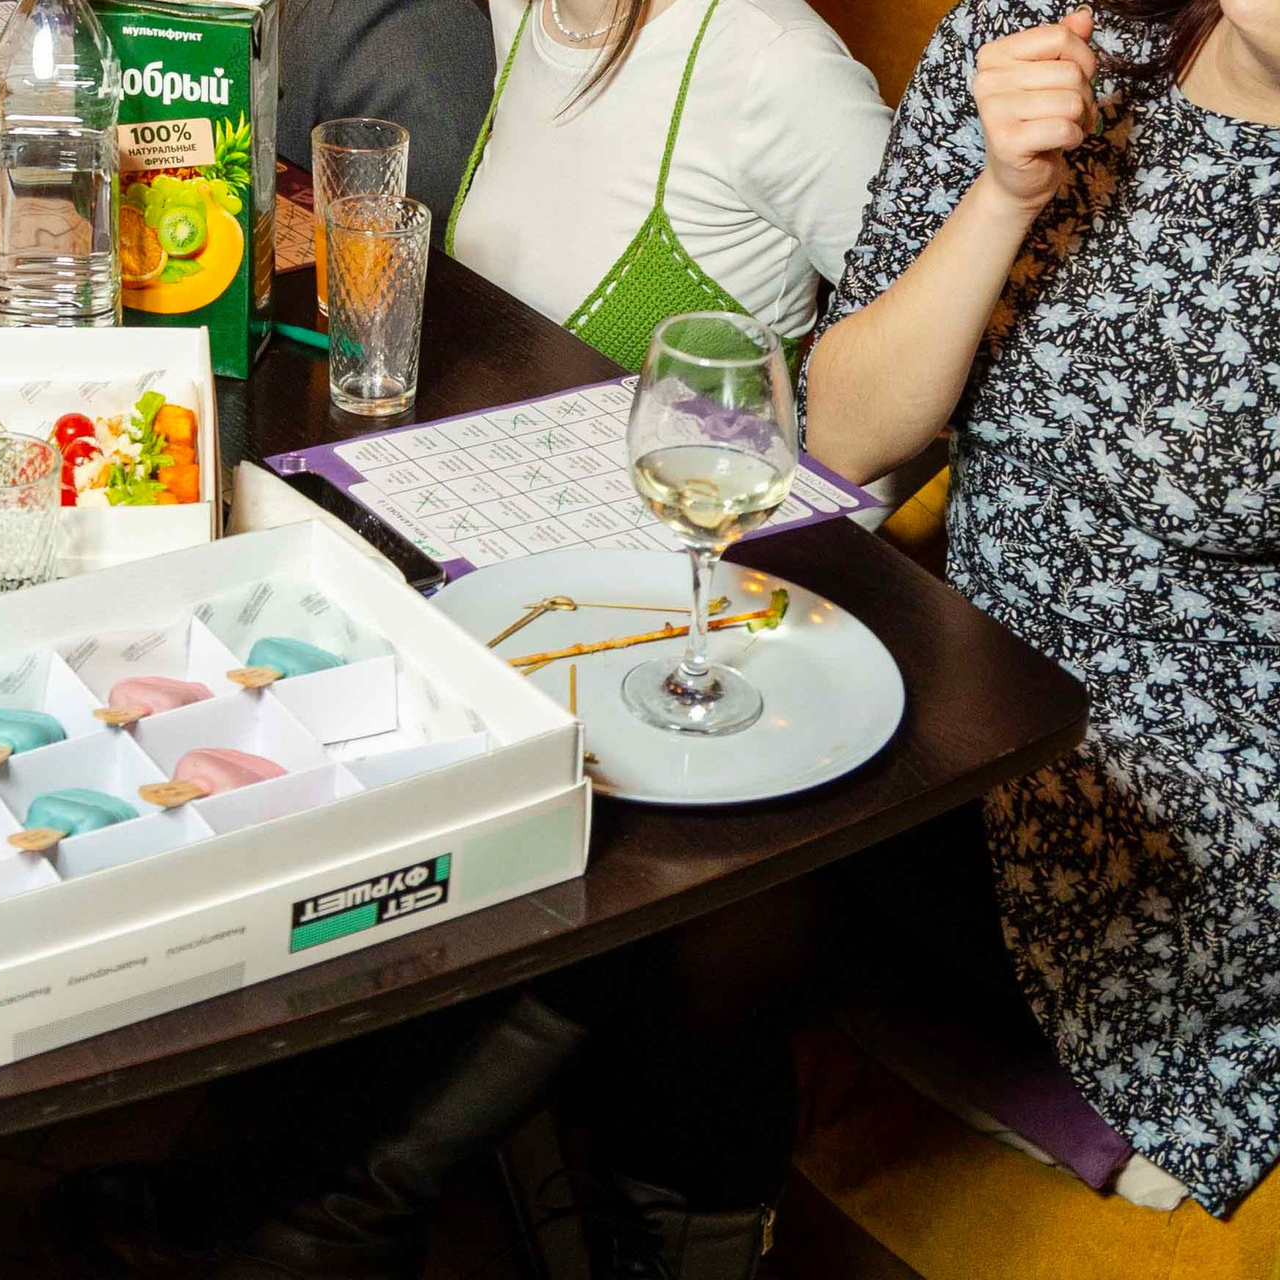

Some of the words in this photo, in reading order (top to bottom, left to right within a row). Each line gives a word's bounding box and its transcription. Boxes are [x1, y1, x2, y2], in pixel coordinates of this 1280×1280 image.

[122, 26, 204, 42] мультифрукт
[130, 123, 192, 145] 100%
[128, 144, 198, 156] НАТУРАЛЬНЫЕ
[144, 156, 185, 166] ФРУКТЫ
[300, 865, 429, 923] ФУРШЕТ
[382, 885, 442, 921] СЕТ
